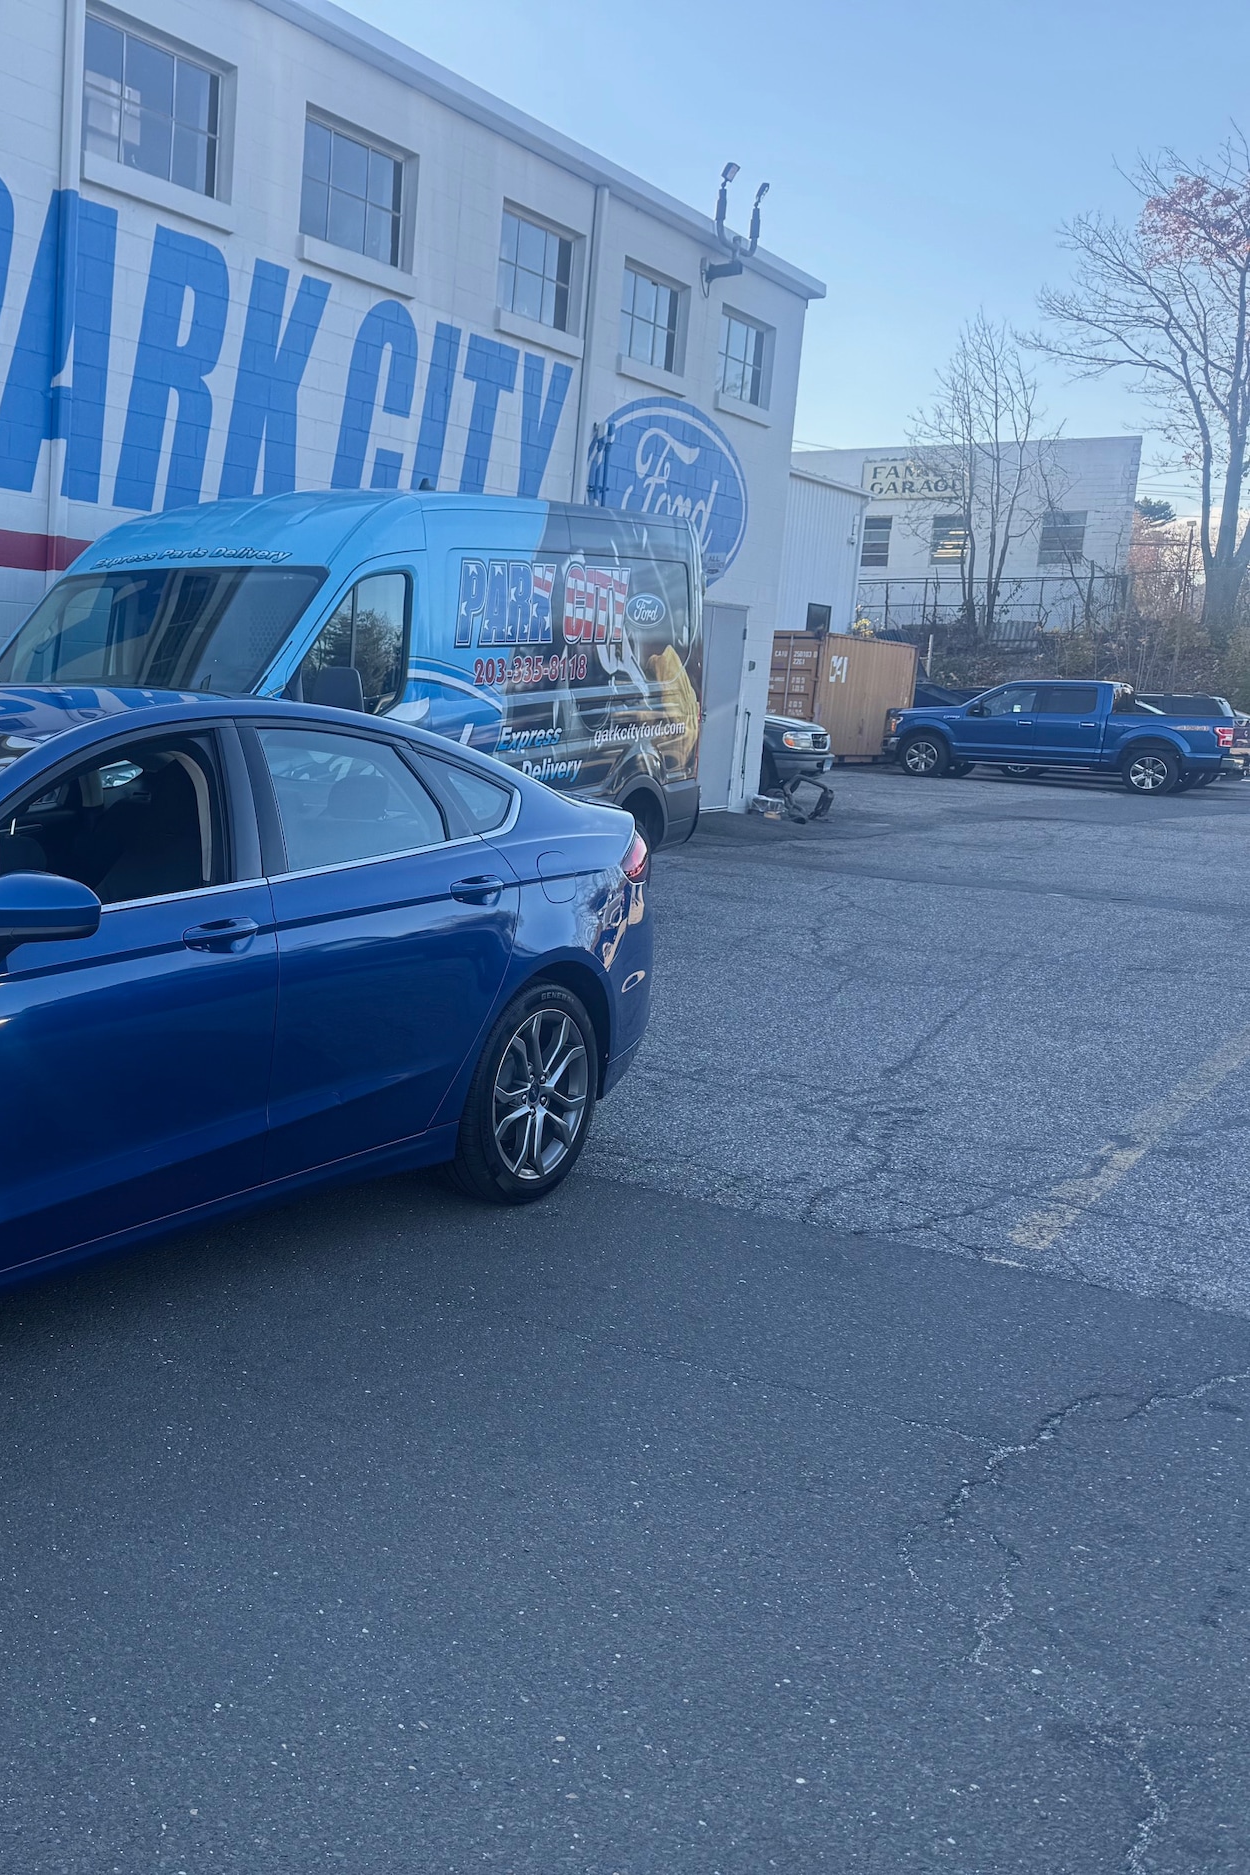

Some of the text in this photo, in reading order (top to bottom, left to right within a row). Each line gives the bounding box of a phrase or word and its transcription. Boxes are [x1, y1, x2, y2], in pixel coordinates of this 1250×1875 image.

[330, 300, 573, 499] CITY
[90, 547, 293, 570] Express Parts Delivery
[455, 557, 631, 648] PARK CITY
[474, 653, 588, 686] 203-335-8118
[496, 725, 563, 751] Express
[594, 720, 686, 748] parkcityford.com
[521, 758, 582, 783] Delivery
